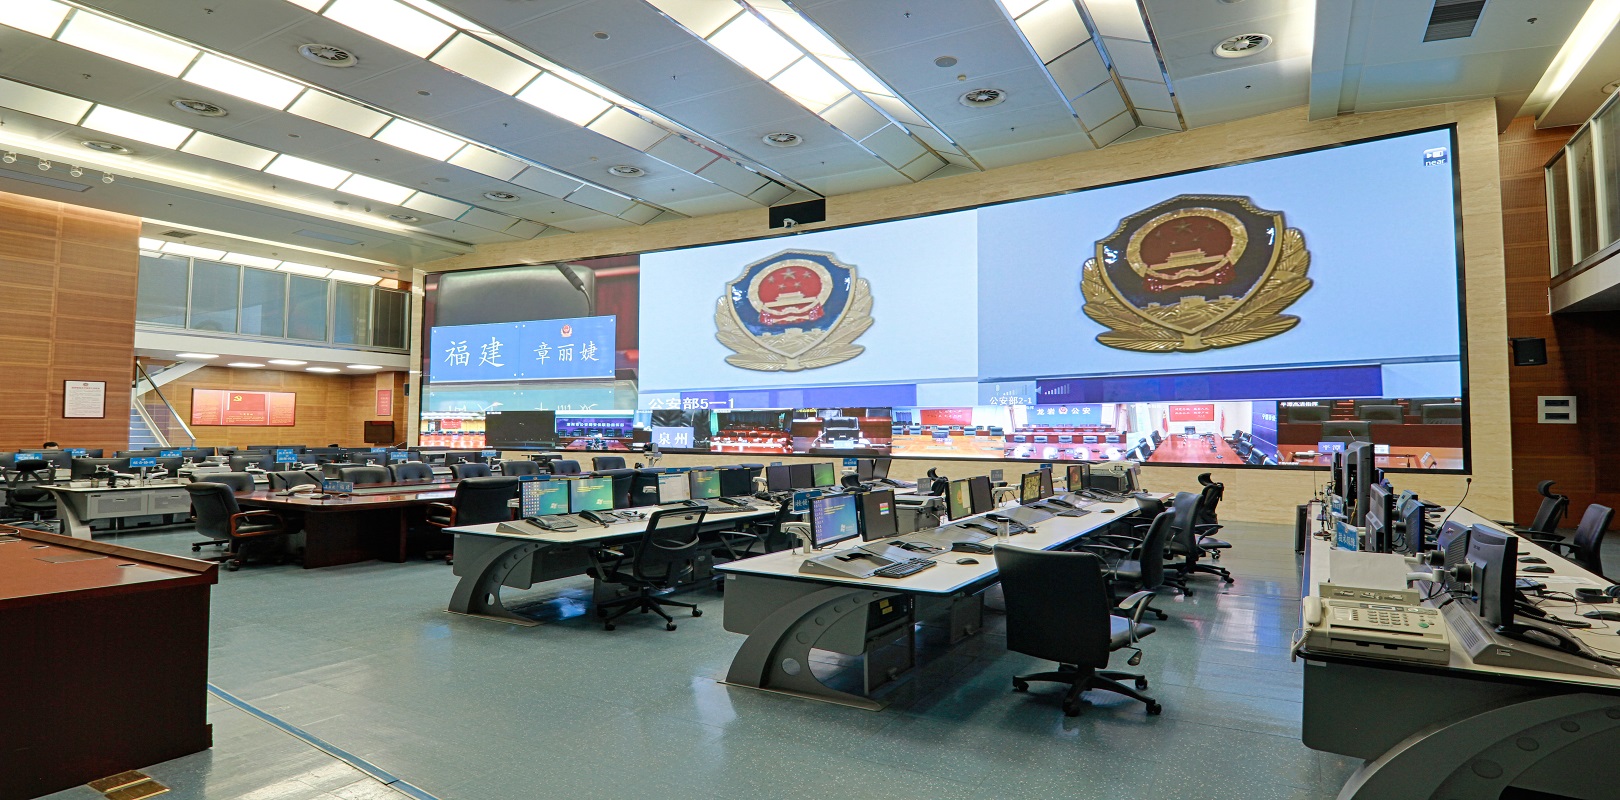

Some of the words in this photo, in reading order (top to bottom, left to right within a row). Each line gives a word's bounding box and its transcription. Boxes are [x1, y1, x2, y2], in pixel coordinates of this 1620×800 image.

[1425, 159, 1446, 167] near
[444, 336, 505, 367] 福建
[533, 340, 600, 365] 章丽婕
[989, 395, 1033, 406] 公安部2-1
[1036, 407, 1056, 416] 龙岩
[1071, 406, 1092, 415] 公安
[657, 431, 688, 446] 泉州
